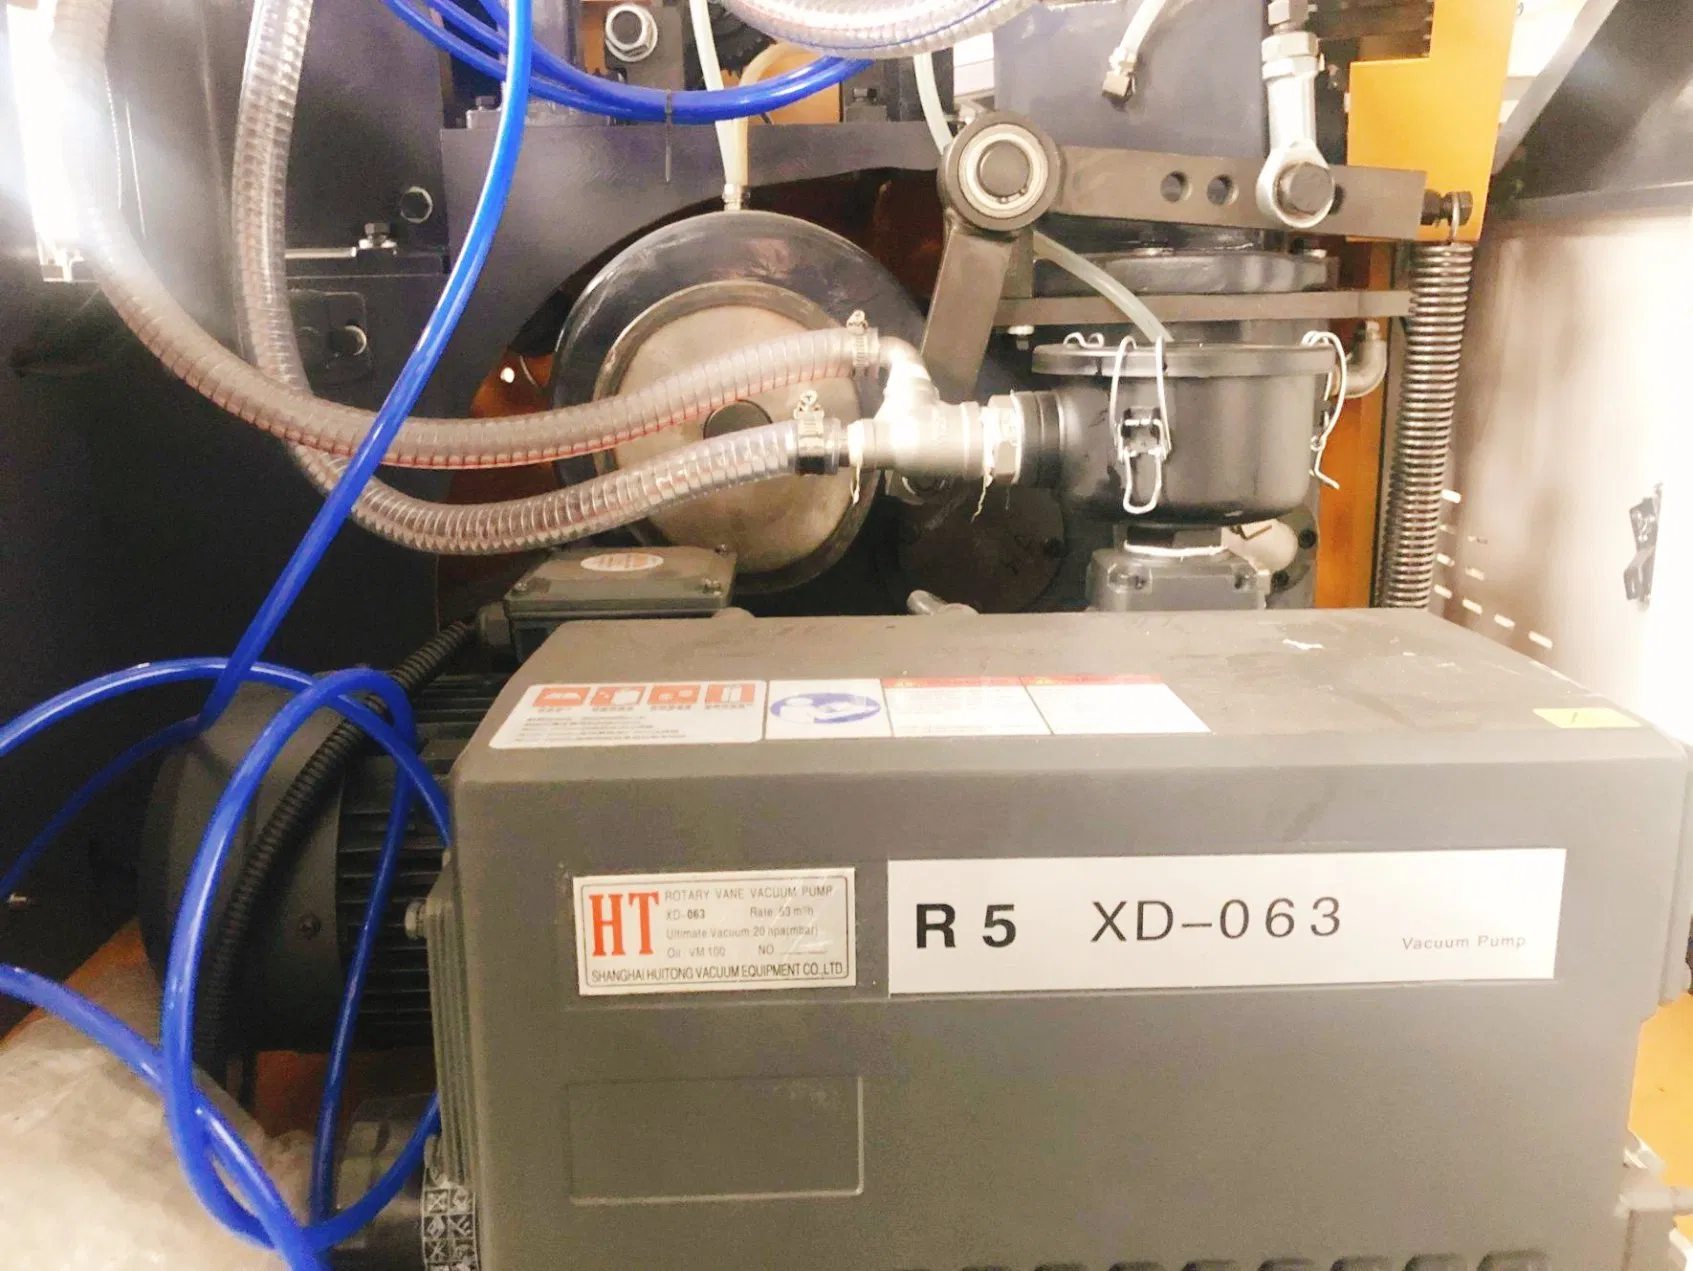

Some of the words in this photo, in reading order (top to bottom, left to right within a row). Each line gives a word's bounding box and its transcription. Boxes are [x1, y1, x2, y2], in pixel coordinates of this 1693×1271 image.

[664, 889, 710, 901] ROTARY
[715, 888, 745, 900] VANE
[749, 887, 797, 899] VACUUM
[802, 885, 833, 897] PUMP
[588, 890, 659, 957] HT
[666, 927, 707, 940] Ultimate
[711, 926, 750, 938] Vacuum
[916, 903, 956, 949] R
[982, 904, 1017, 948] 5
[1091, 896, 1341, 942] XD-063
[1402, 937, 1469, 950] Vacuum
[1478, 934, 1527, 949] Pump
[592, 967, 645, 982] SHANGHAI
[647, 967, 694, 980] HUITONG
[695, 964, 739, 979] VACUUM
[741, 962, 800, 978] EQUIPMENT
